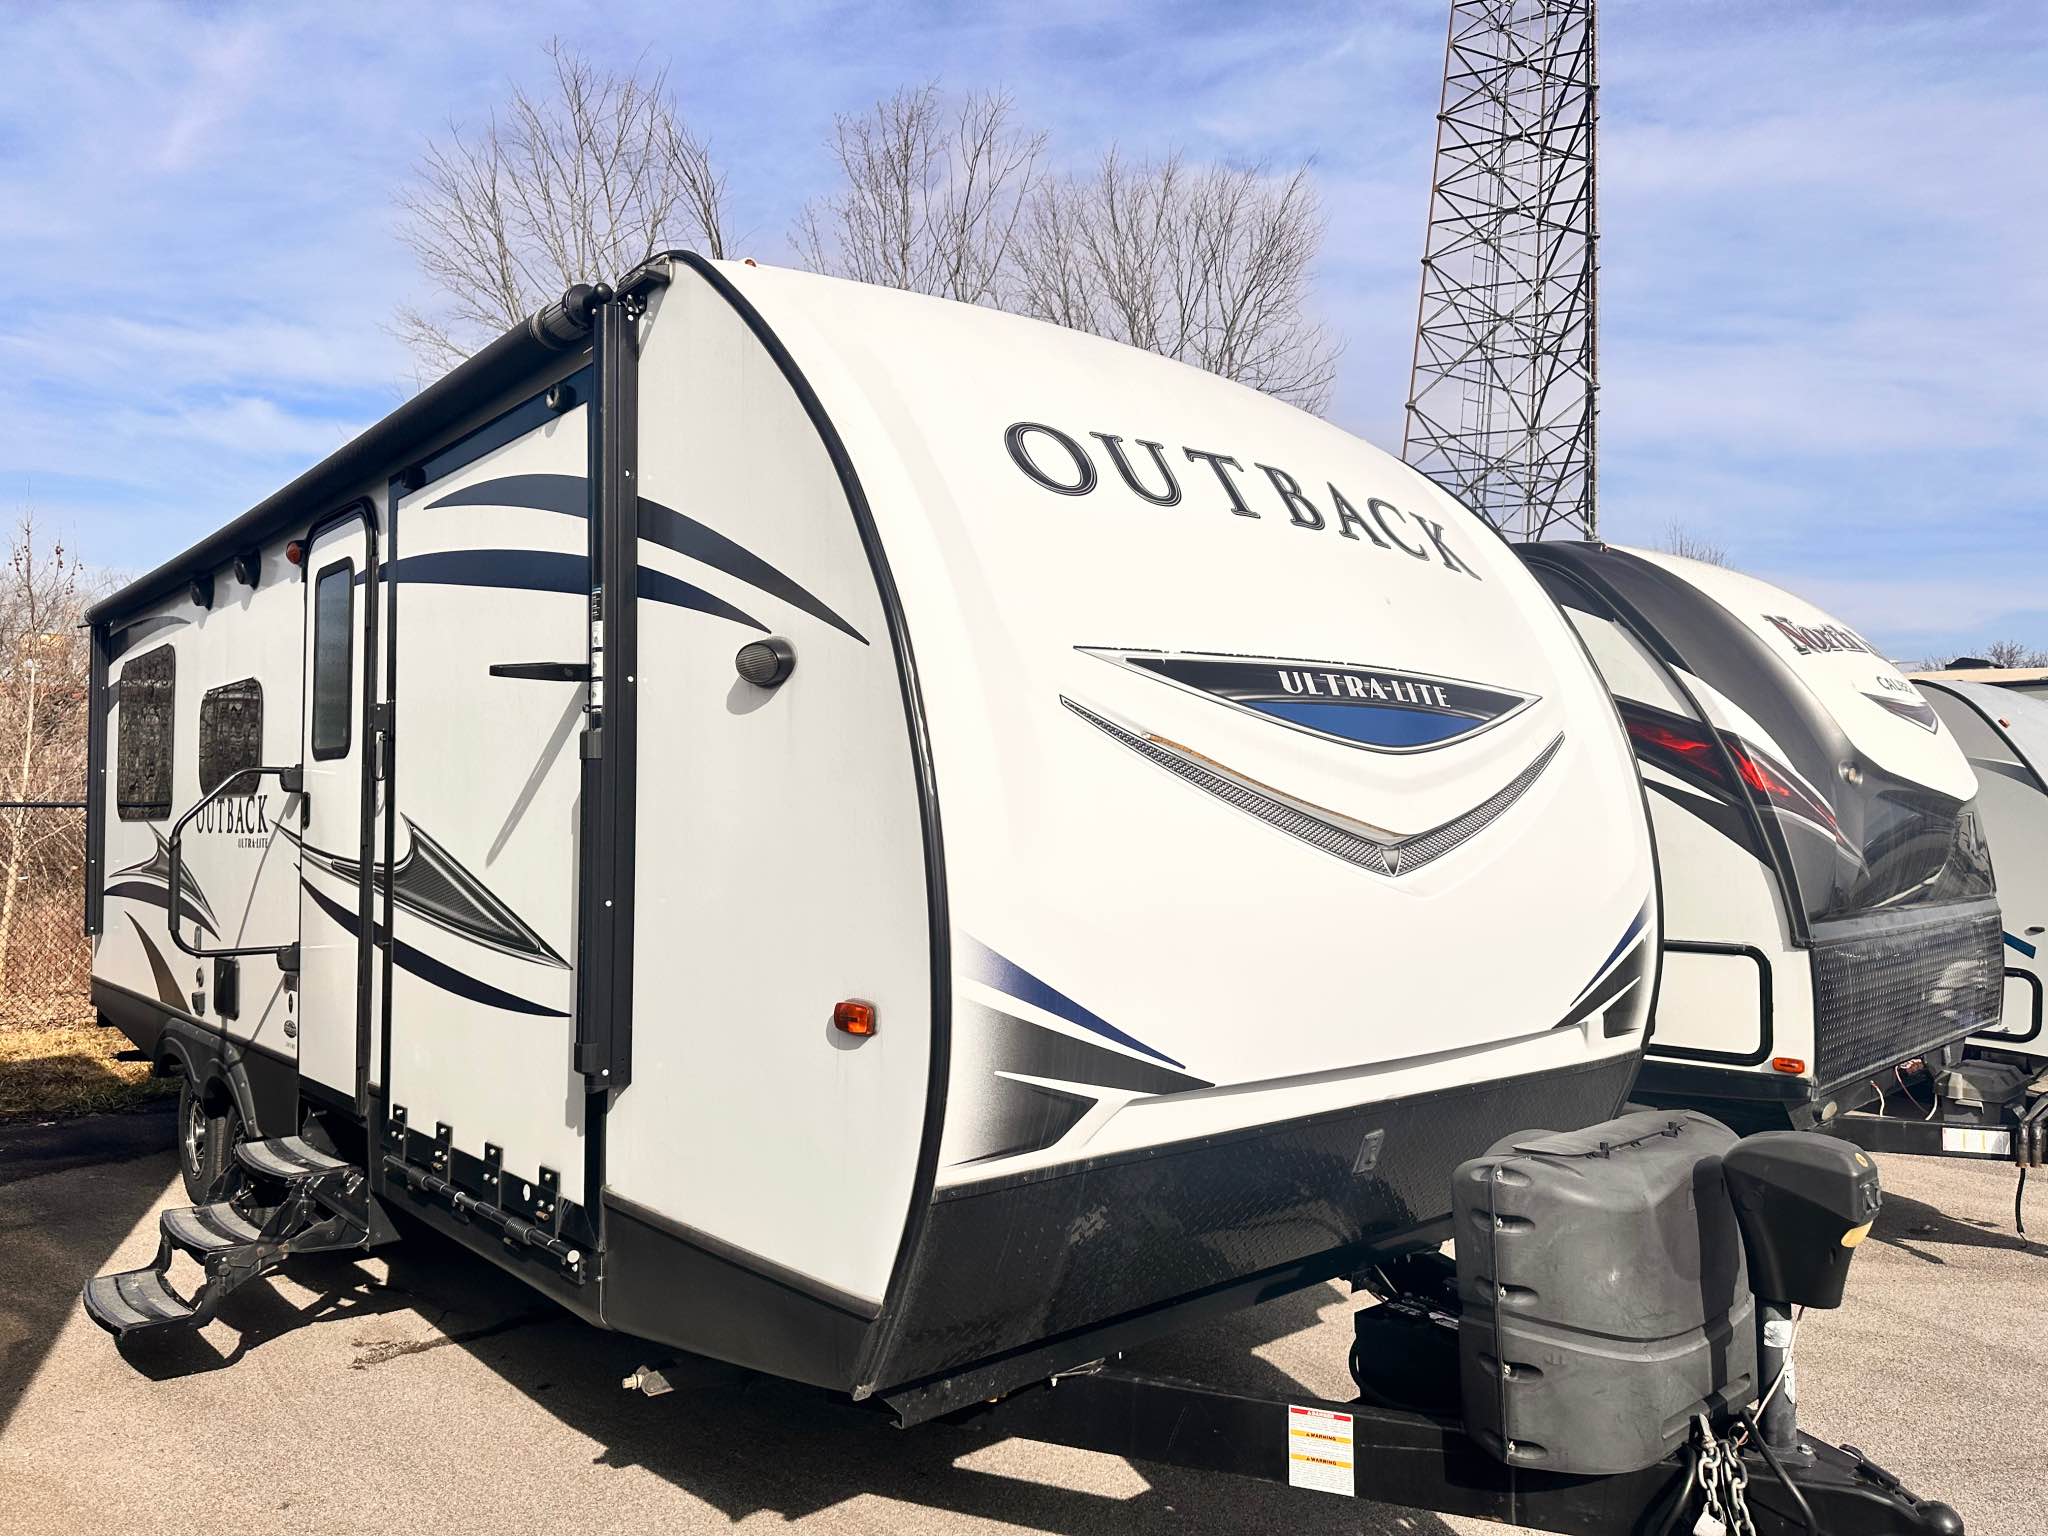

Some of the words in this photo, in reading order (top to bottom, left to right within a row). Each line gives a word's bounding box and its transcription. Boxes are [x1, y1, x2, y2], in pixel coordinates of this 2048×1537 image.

[1004, 421, 1482, 581] OUTBACK
[1277, 670, 1451, 708] ULTRA-LITE
[196, 795, 268, 833] OUTBACK
[1311, 1433, 1337, 1441] WARNING
[1311, 1457, 1337, 1465] WARNING
